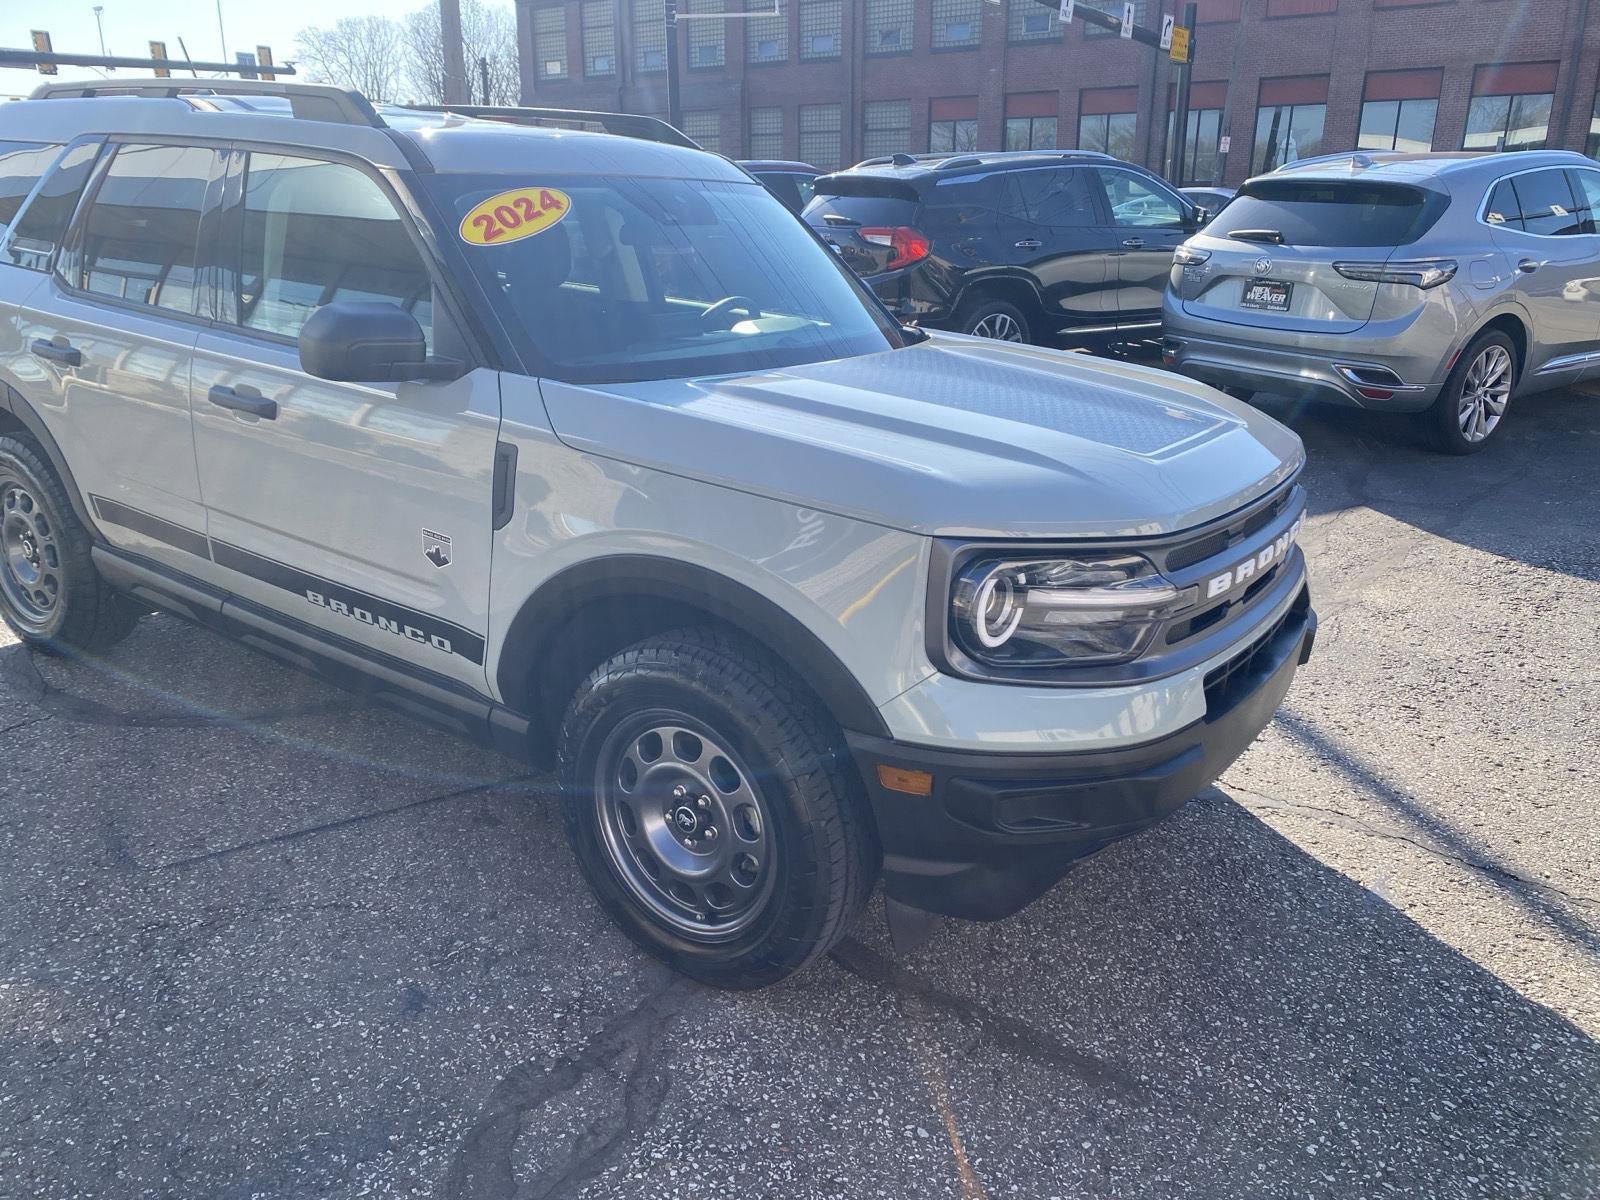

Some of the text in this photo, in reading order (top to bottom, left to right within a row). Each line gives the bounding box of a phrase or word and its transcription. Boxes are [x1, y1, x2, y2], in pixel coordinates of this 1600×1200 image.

[472, 190, 564, 242] 2024
[1246, 291, 1286, 303] WEAVER
[305, 589, 453, 654] BRONCO
